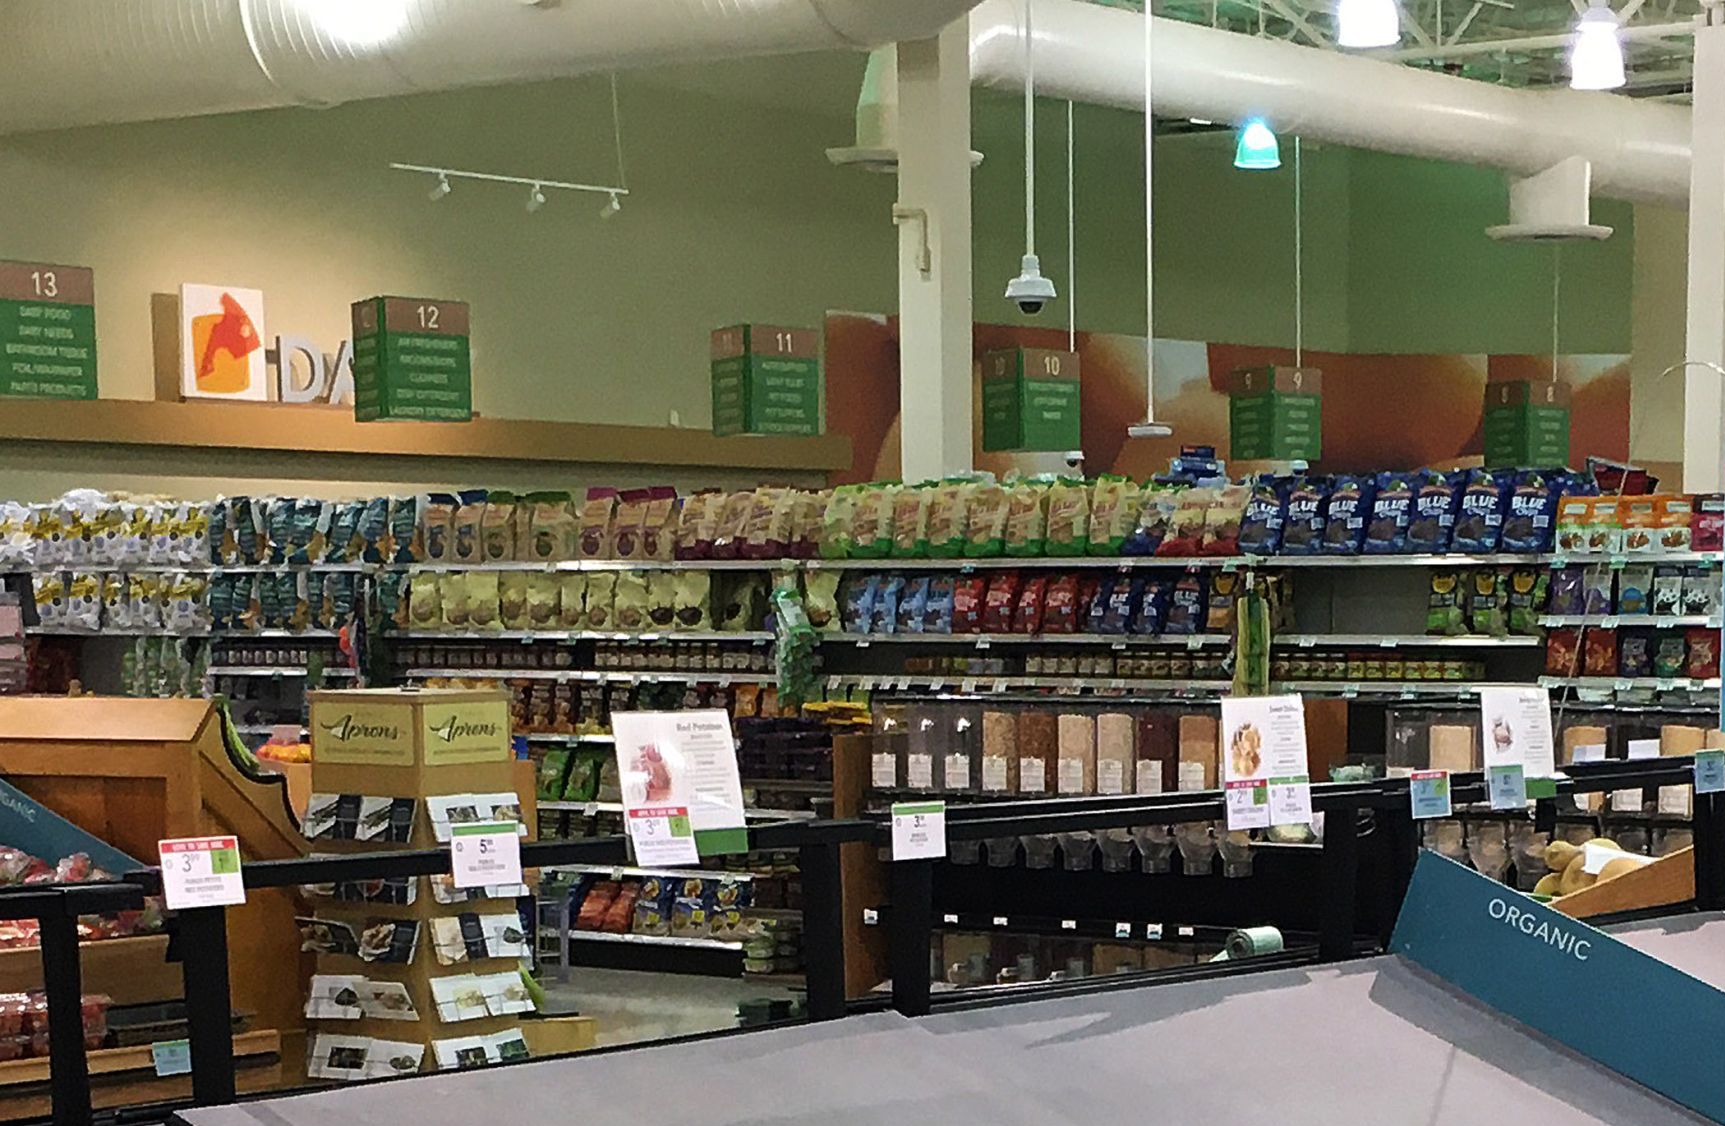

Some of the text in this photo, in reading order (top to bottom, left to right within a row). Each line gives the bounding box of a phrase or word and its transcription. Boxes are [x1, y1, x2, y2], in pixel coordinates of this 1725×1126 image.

[32, 271, 58, 297] 13
[416, 305, 440, 329] 12
[776, 332, 793, 353] 11
[279, 336, 354, 405] DA
[1045, 356, 1061, 376] 10
[1417, 495, 1452, 512] BLUE
[1462, 494, 1499, 510] BLUE
[1512, 495, 1547, 510] BLUE
[320, 714, 399, 742] Aprons
[430, 714, 497, 743] Aprons
[1487, 896, 1593, 964] ORGANIC
